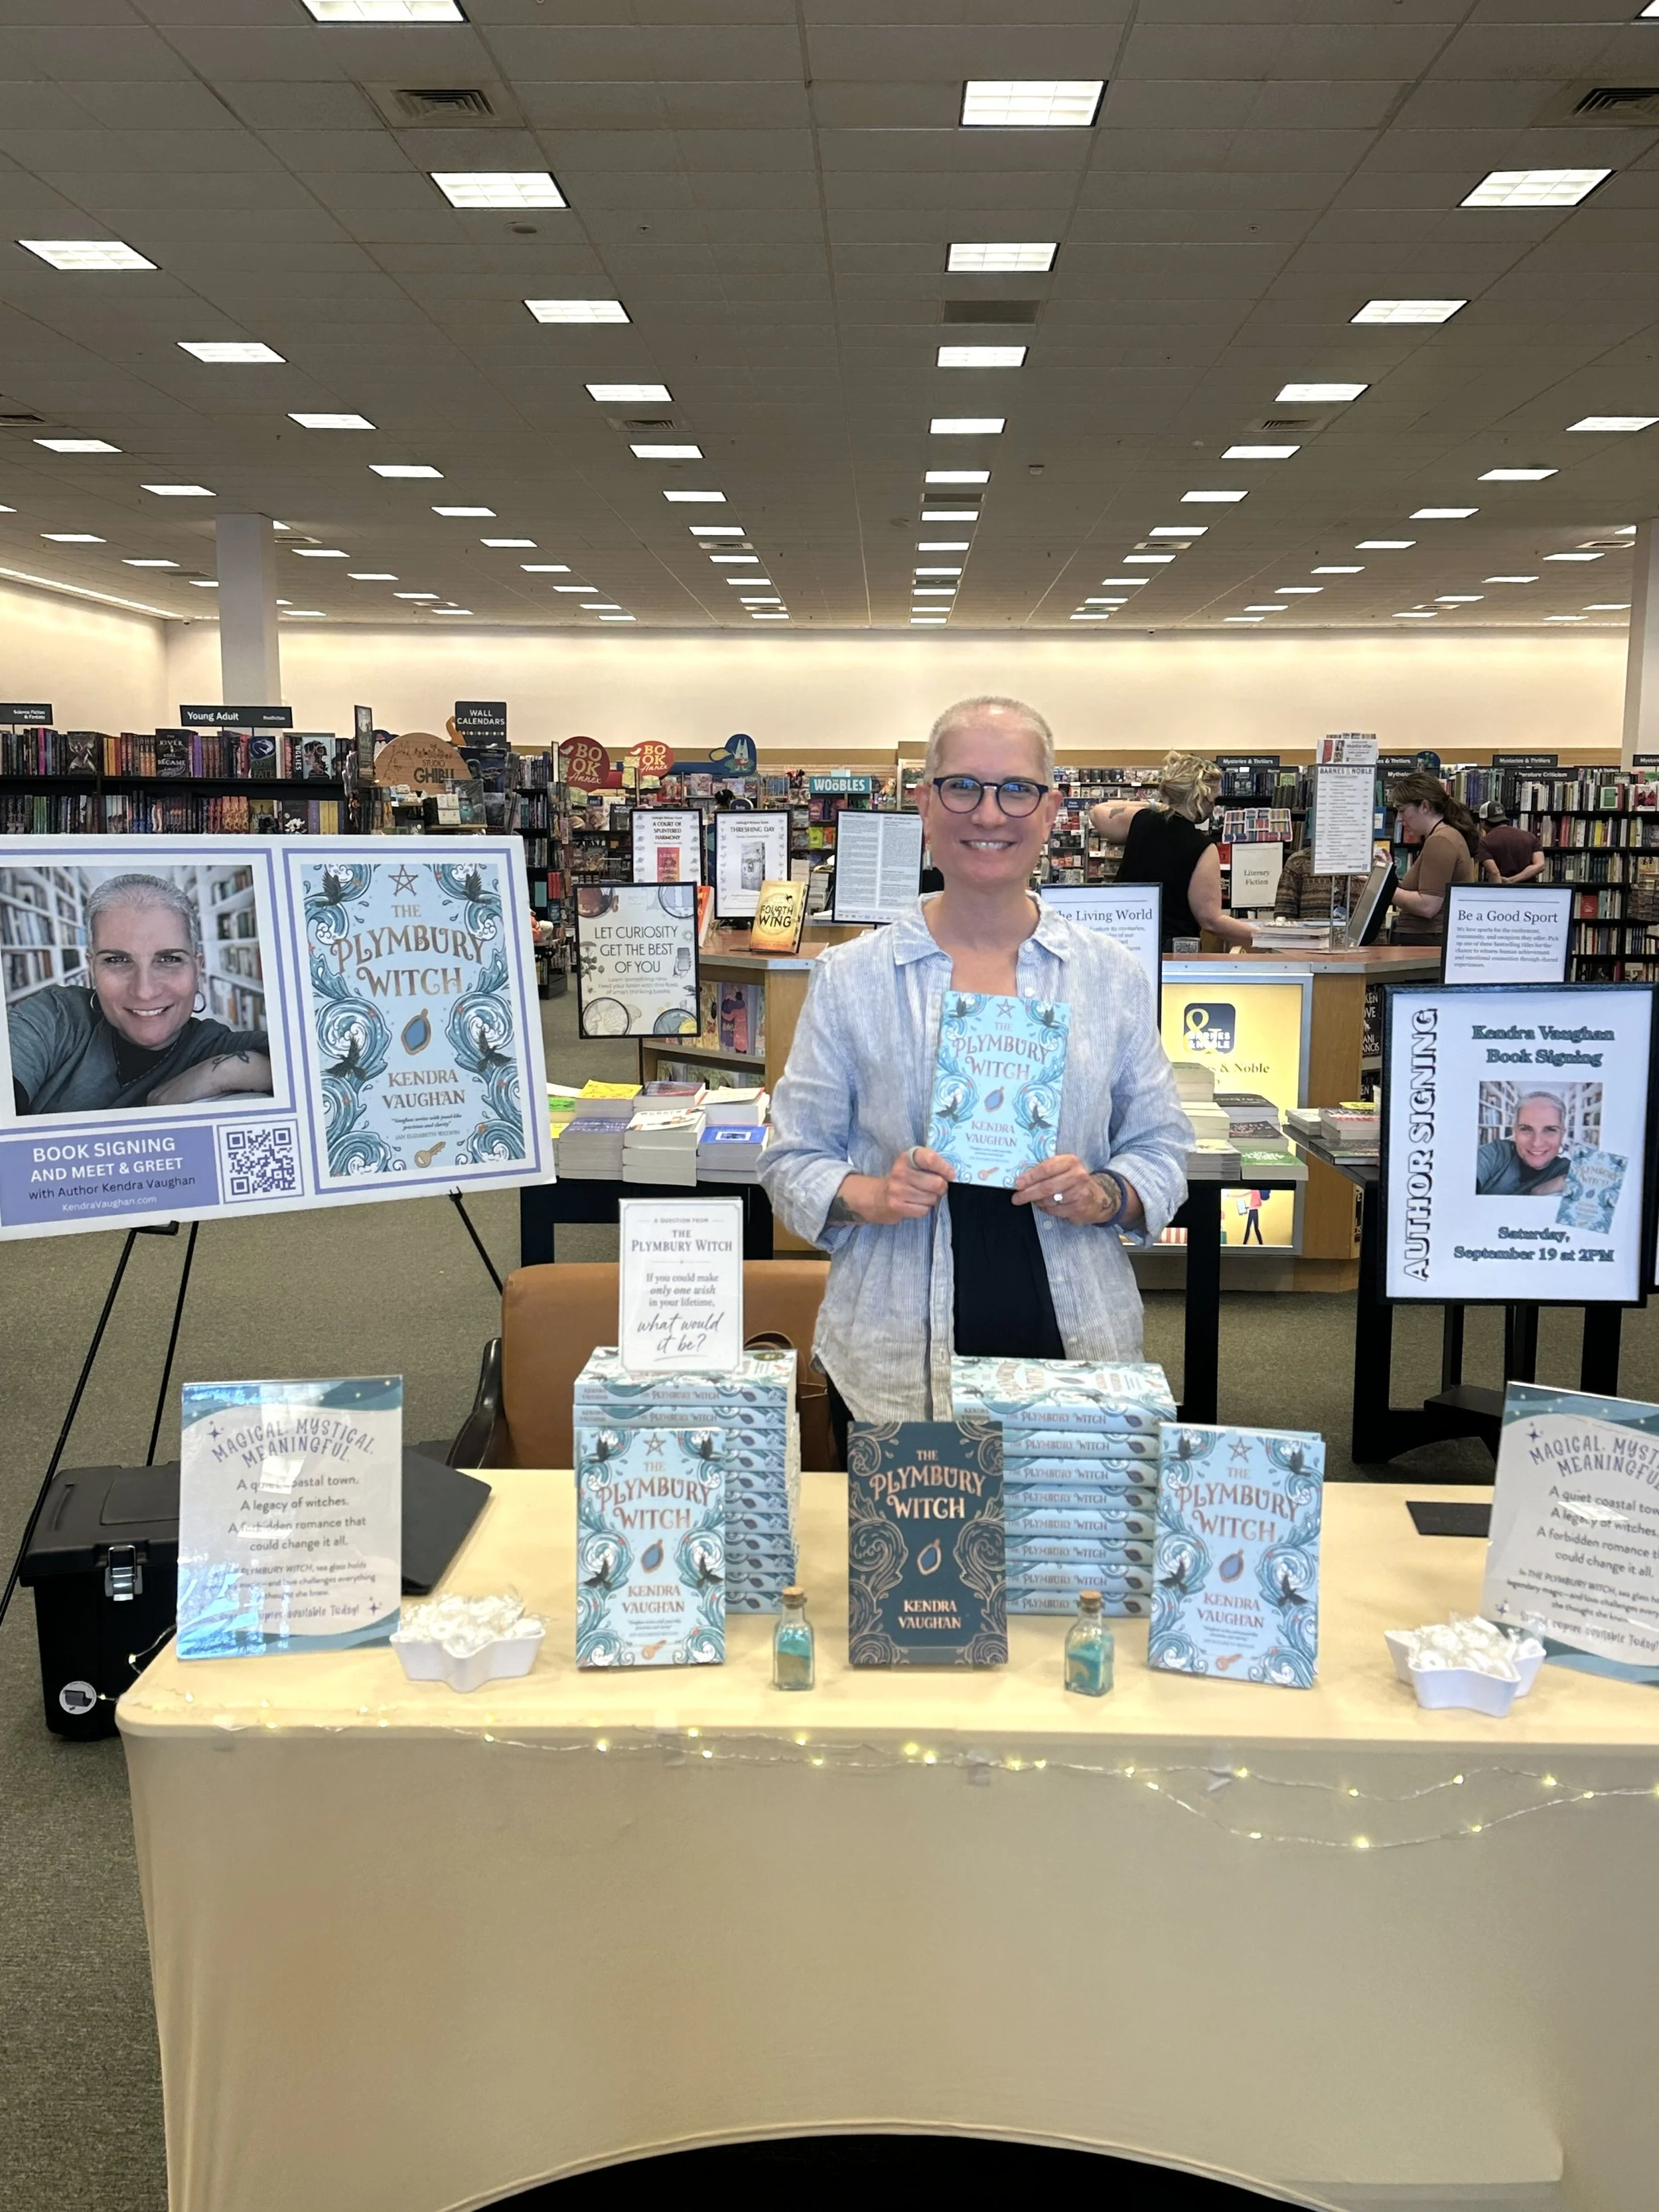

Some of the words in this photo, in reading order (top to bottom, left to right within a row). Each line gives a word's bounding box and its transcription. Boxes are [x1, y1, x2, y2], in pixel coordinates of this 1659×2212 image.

[187, 711, 214, 721] Young
[216, 712, 239, 721] Adult
[568, 773, 601, 784] Annex
[1244, 869, 1270, 879] Literary
[391, 904, 421, 918] THE
[760, 905, 793, 917] FOURTH
[1076, 911, 1113, 923] Living
[1116, 909, 1153, 921] World
[1458, 910, 1473, 921] Be
[1486, 911, 1520, 922] Good
[1524, 911, 1558, 924] Sport
[759, 915, 792, 928] WING
[595, 926, 613, 938] LET
[616, 926, 678, 938] CURIOSITY
[330, 924, 486, 974] PLYMBURY
[600, 944, 622, 956] GET
[624, 944, 645, 956] THE
[648, 943, 674, 956] BEST
[614, 961, 632, 973] OF
[635, 960, 660, 973] YOU
[356, 966, 464, 997] WITCH
[995, 1021, 1013, 1031] THE
[1472, 1025, 1535, 1041] Kendra
[1539, 1025, 1615, 1043] Vaughan
[952, 1033, 1052, 1065] PLYMBURY
[1486, 1049, 1532, 1064] Book
[1536, 1049, 1603, 1067] Signing
[965, 1056, 1030, 1080] WITCH
[1220, 1063, 1230, 1072] &
[1235, 1063, 1270, 1073] Noble
[1409, 1008, 1438, 1143] SIGNING
[388, 1069, 459, 1087] KENDRA
[382, 1089, 465, 1109] VAUGHAN
[972, 1120, 1015, 1134] KENDRA
[966, 1134, 1018, 1147] VAUGHAN
[33, 1144, 90, 1163] BOOK
[94, 1137, 175, 1157] SIGNING
[31, 1167, 67, 1183] AND
[72, 1163, 115, 1179] MEET
[119, 1162, 130, 1174] &
[133, 1157, 183, 1173] GREET
[29, 1187, 54, 1200] with
[58, 1184, 98, 1198] Author
[102, 1179, 144, 1193] Kendra
[146, 1175, 196, 1191] Vaughan
[62, 1195, 157, 1212] KendraVaughan.com
[1404, 1149, 1433, 1282] AUTHOR
[1498, 1226, 1570, 1243] Saturday,
[632, 1240, 691, 1252] PLYMBURY
[695, 1240, 732, 1252] WITCH
[1454, 1246, 1536, 1261] September
[1538, 1248, 1557, 1260] 19
[1560, 1249, 1575, 1261] at
[1578, 1249, 1615, 1262] 2PM
[646, 1273, 653, 1282] If
[655, 1275, 670, 1284] you
[672, 1273, 695, 1282] could
[697, 1273, 719, 1282] make
[650, 1285, 671, 1296] only
[693, 1285, 715, 1294] wish
[660, 1299, 678, 1309] your
[680, 1297, 715, 1307] lifetime,
[637, 1313, 682, 1333] what
[680, 1312, 724, 1332] would
[657, 1335, 676, 1354] it
[678, 1333, 707, 1352] be?
[692, 1390, 720, 1400] WITCH
[1022, 1412, 1070, 1423] PLYMBURY
[1074, 1413, 1106, 1424] WITCH
[212, 1424, 289, 1463] MAGICAL.
[297, 1418, 374, 1455] MYSTICAL.
[242, 1436, 350, 1468] MEANINGFUL.
[916, 1449, 938, 1461] THE
[1529, 1435, 1606, 1465] MAGICAL.
[644, 1462, 666, 1472] THE
[1025, 1468, 1072, 1479] PLYMBURY
[1075, 1470, 1108, 1480] WITCH
[1226, 1467, 1250, 1479] THE
[327, 1477, 359, 1486] town.
[869, 1465, 987, 1501] PLYMBURY
[596, 1476, 711, 1511] PLYMBURY
[1562, 1489, 1592, 1503] quiet
[1595, 1497, 1636, 1511] coastal
[240, 1500, 250, 1511] A
[253, 1500, 288, 1514] legacy
[291, 1497, 304, 1509] of
[306, 1496, 349, 1507] witches.
[887, 1495, 966, 1519] WITCH
[1175, 1482, 1299, 1522] PLYMBURY
[295, 1519, 342, 1529] romance
[344, 1516, 366, 1526] that
[613, 1505, 691, 1530] WITCH
[1192, 1509, 1275, 1542] WITCH
[250, 1540, 279, 1551] could
[282, 1539, 320, 1552] change
[333, 1536, 348, 1546] all.
[1548, 1528, 1599, 1547] forbidden
[628, 1584, 681, 1597] KENDRA
[622, 1600, 685, 1614] VAUGHAN
[903, 1599, 957, 1613] KENDRA
[1204, 1593, 1261, 1611] KENDRA
[898, 1616, 962, 1630] VAUGHAN
[1197, 1609, 1264, 1628] VAUGHAN
